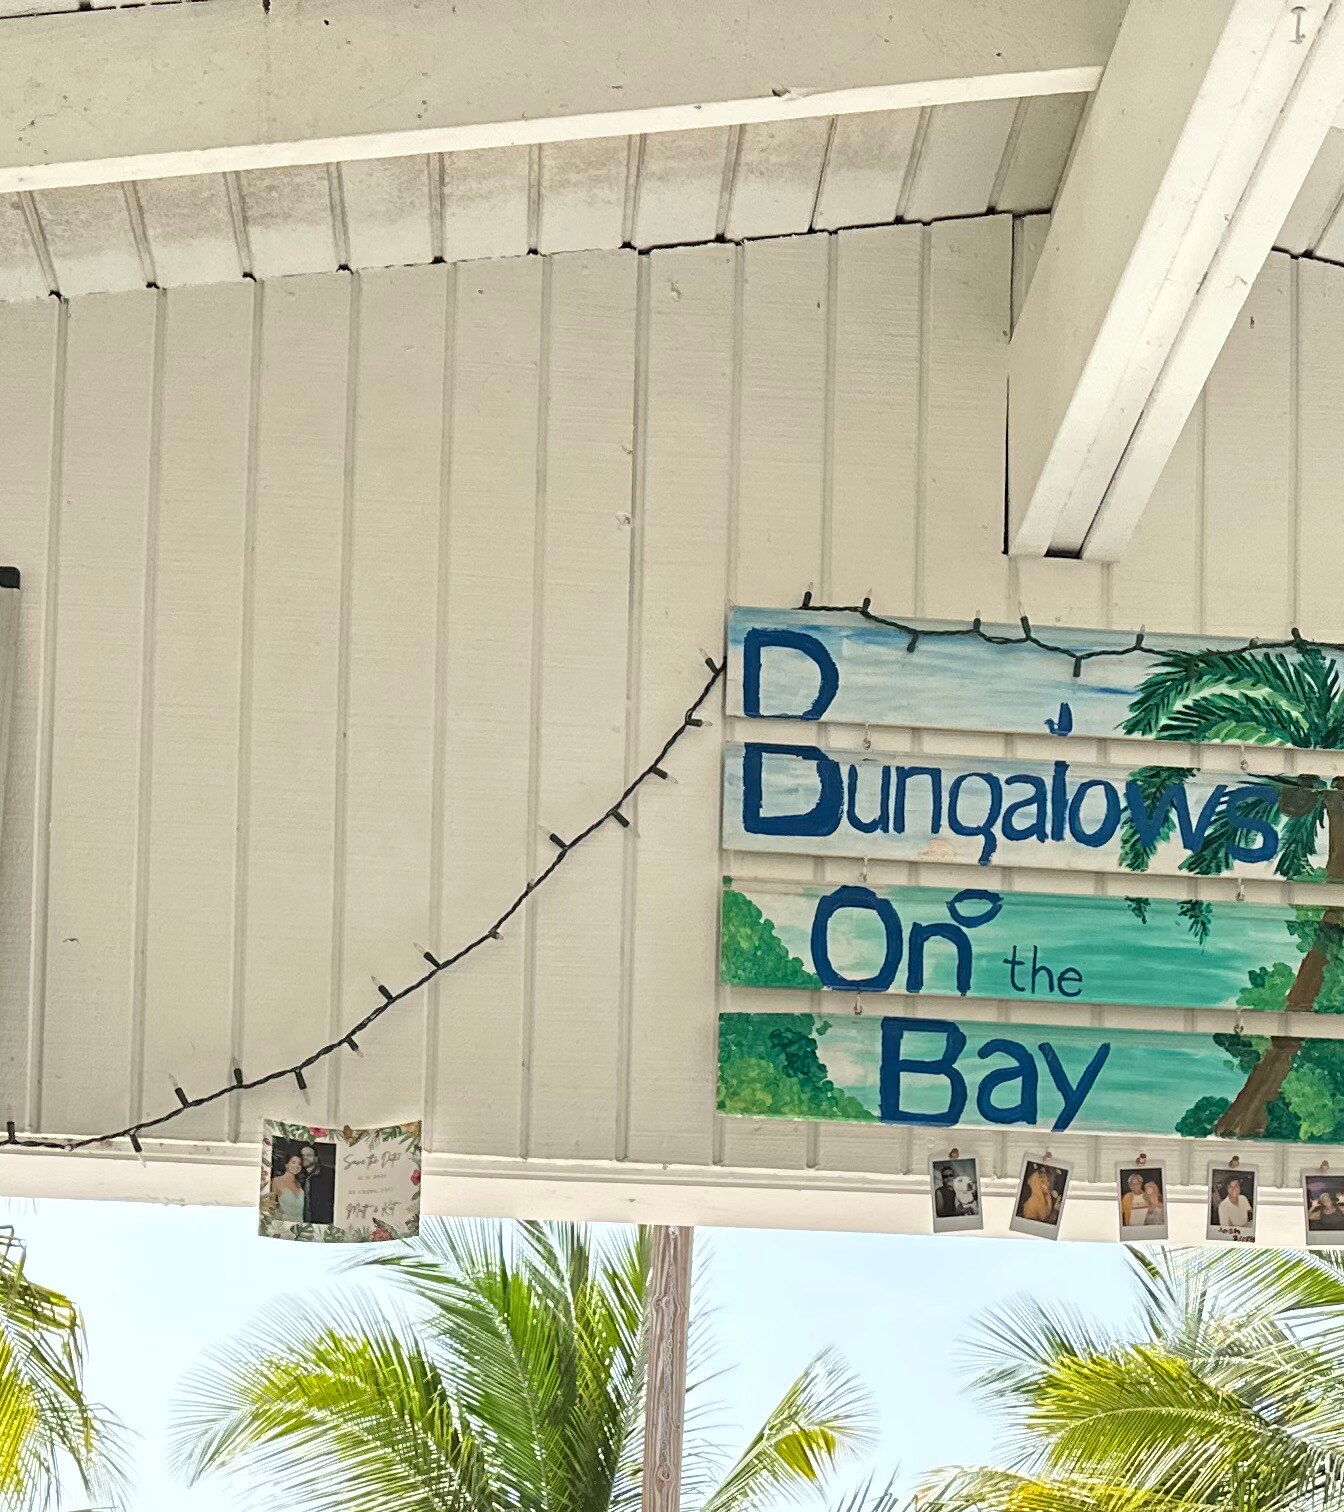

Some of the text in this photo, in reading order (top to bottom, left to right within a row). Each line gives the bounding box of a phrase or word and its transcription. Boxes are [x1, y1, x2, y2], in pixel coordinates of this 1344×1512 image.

[810, 885, 1084, 998] On the
[880, 1016, 1111, 1133] Bay
